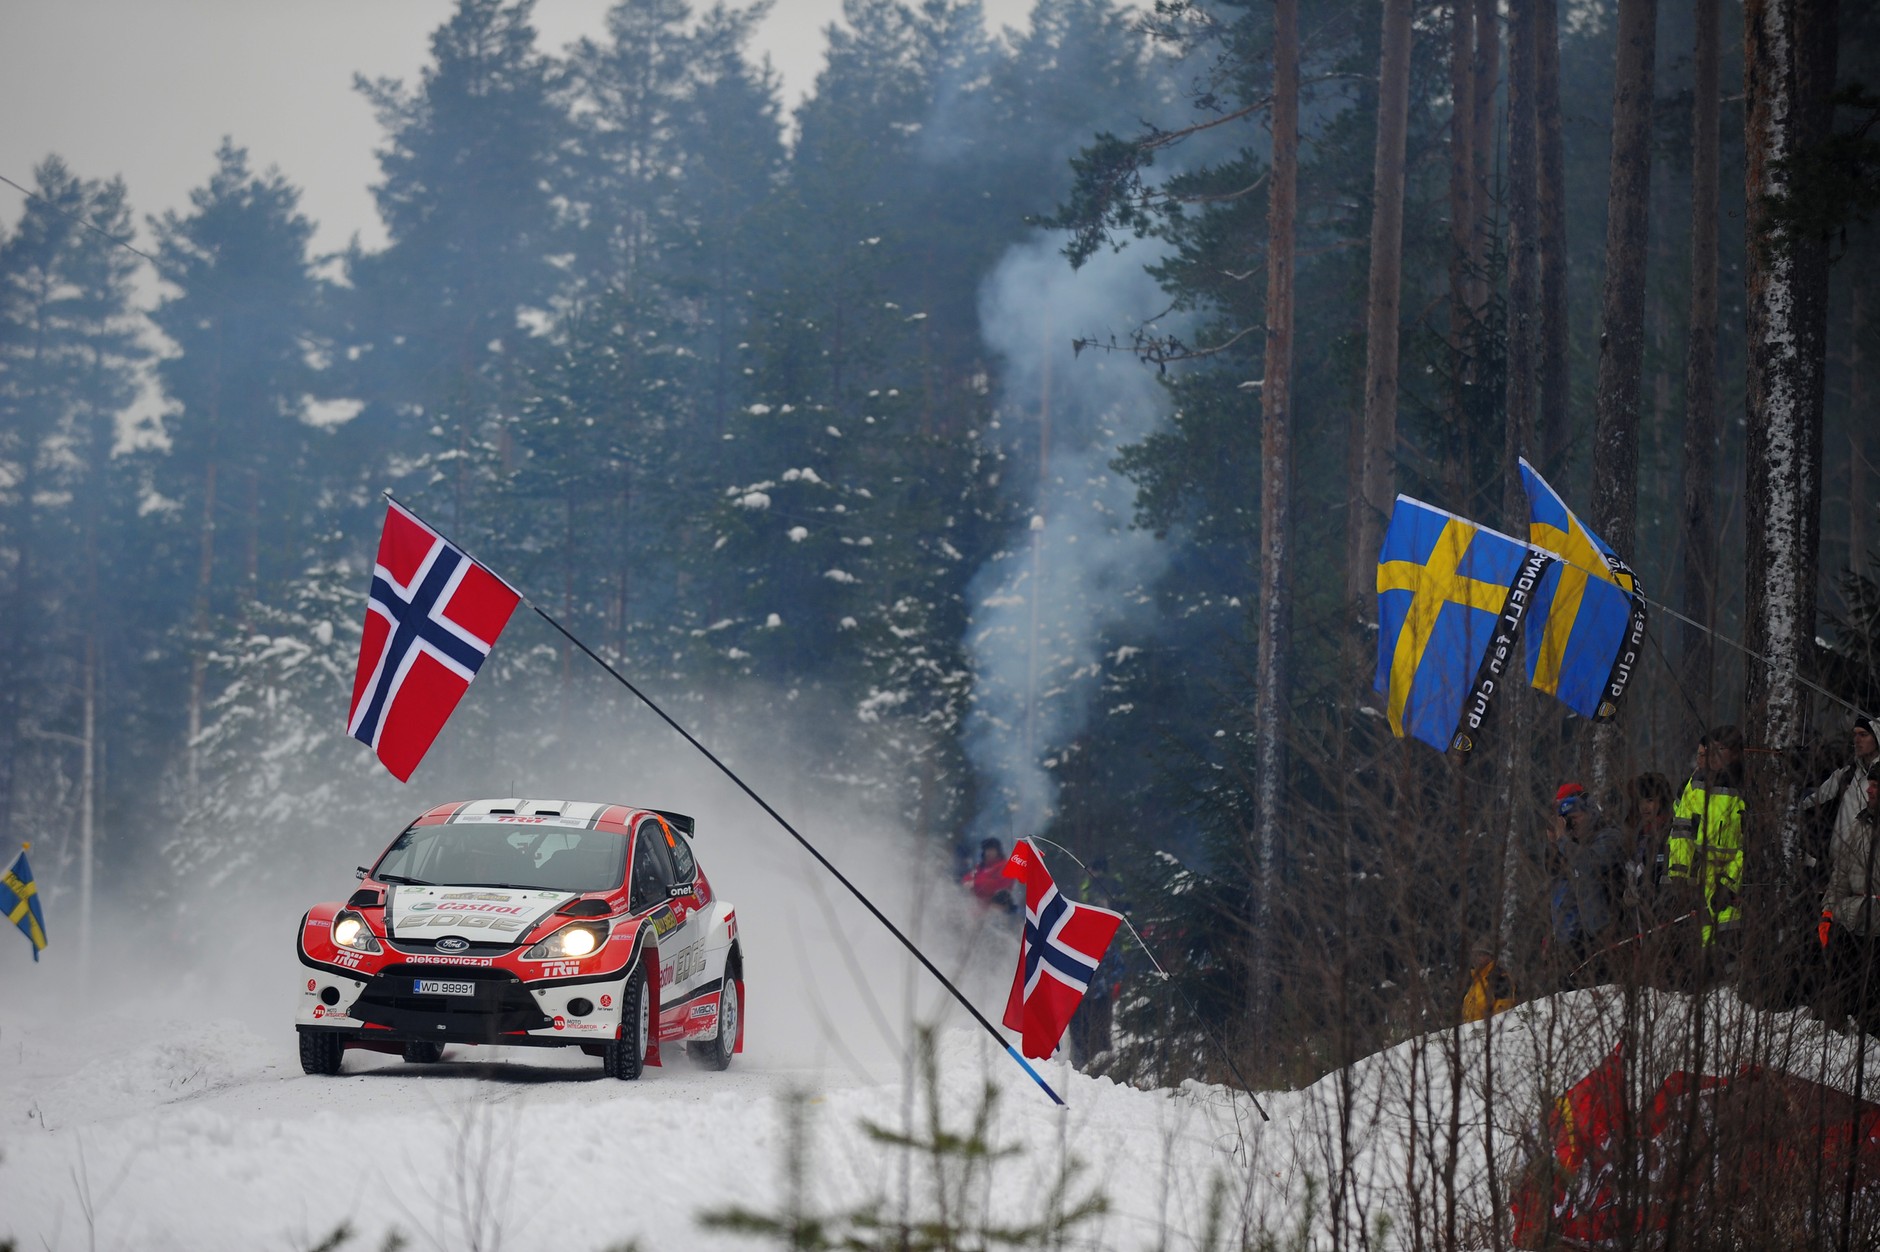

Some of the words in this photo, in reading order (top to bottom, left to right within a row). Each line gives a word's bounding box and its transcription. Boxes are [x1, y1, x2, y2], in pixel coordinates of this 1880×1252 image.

[437, 902, 524, 915] Castrol
[396, 913, 529, 932] EDGE
[442, 939, 462, 949] Ford
[332, 949, 364, 968] TRW
[405, 955, 493, 967] oleksowicz.pl
[541, 960, 580, 977] TRW
[421, 982, 439, 992] WD
[442, 983, 473, 993] 99991
